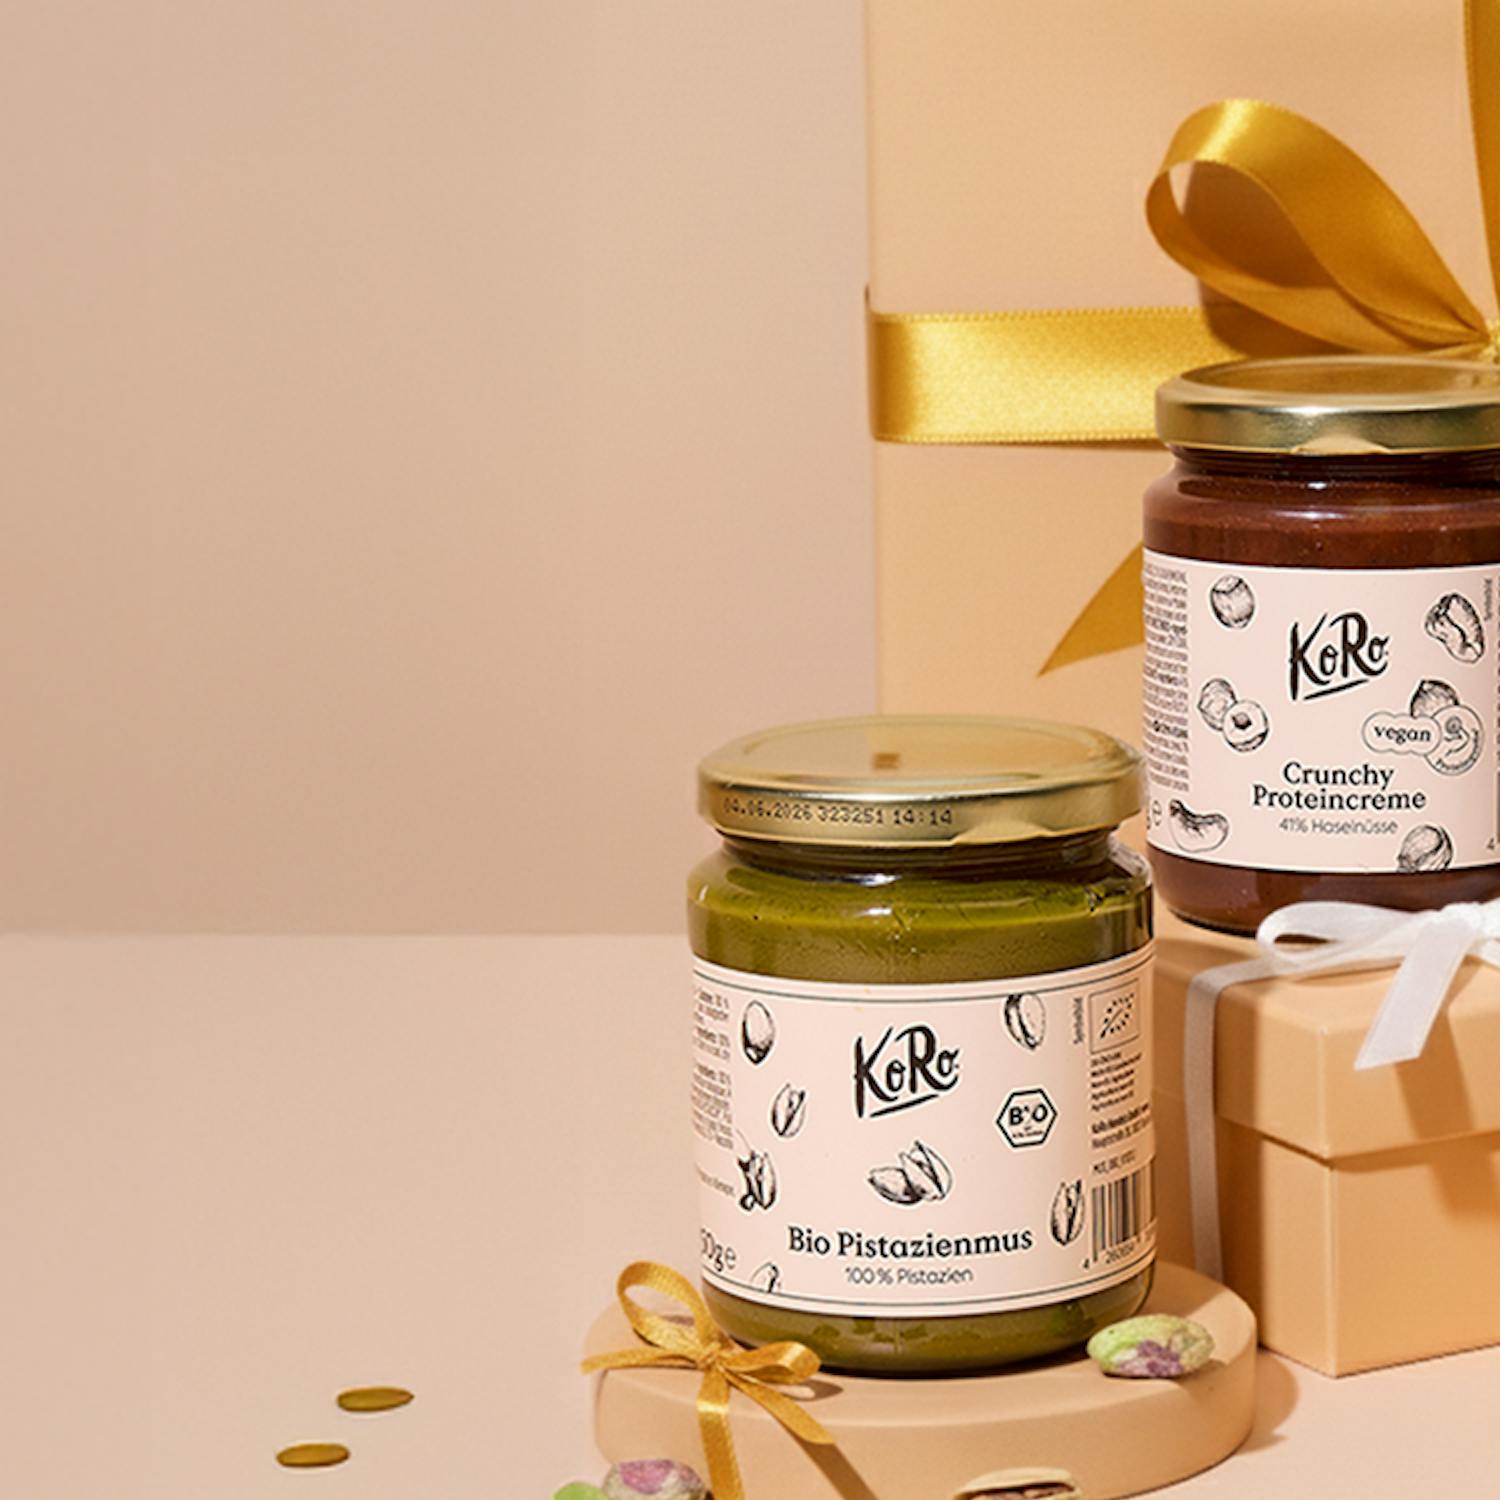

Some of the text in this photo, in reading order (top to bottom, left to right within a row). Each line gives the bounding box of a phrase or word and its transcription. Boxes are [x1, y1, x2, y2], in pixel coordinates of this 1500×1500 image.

[1289, 611, 1390, 702] KoRo
[1373, 723, 1431, 745] vegan
[1283, 760, 1395, 792] Crunchy
[1252, 781, 1427, 811] Proteincreme
[817, 806, 884, 824] 323251
[893, 808, 953, 825] 14:14
[1278, 817, 1399, 836] 41% Haselnüsse
[853, 1025, 960, 1119] KoRo
[787, 1225, 1033, 1259] Bio Pistazienmus
[897, 1266, 974, 1286] Pistazien
